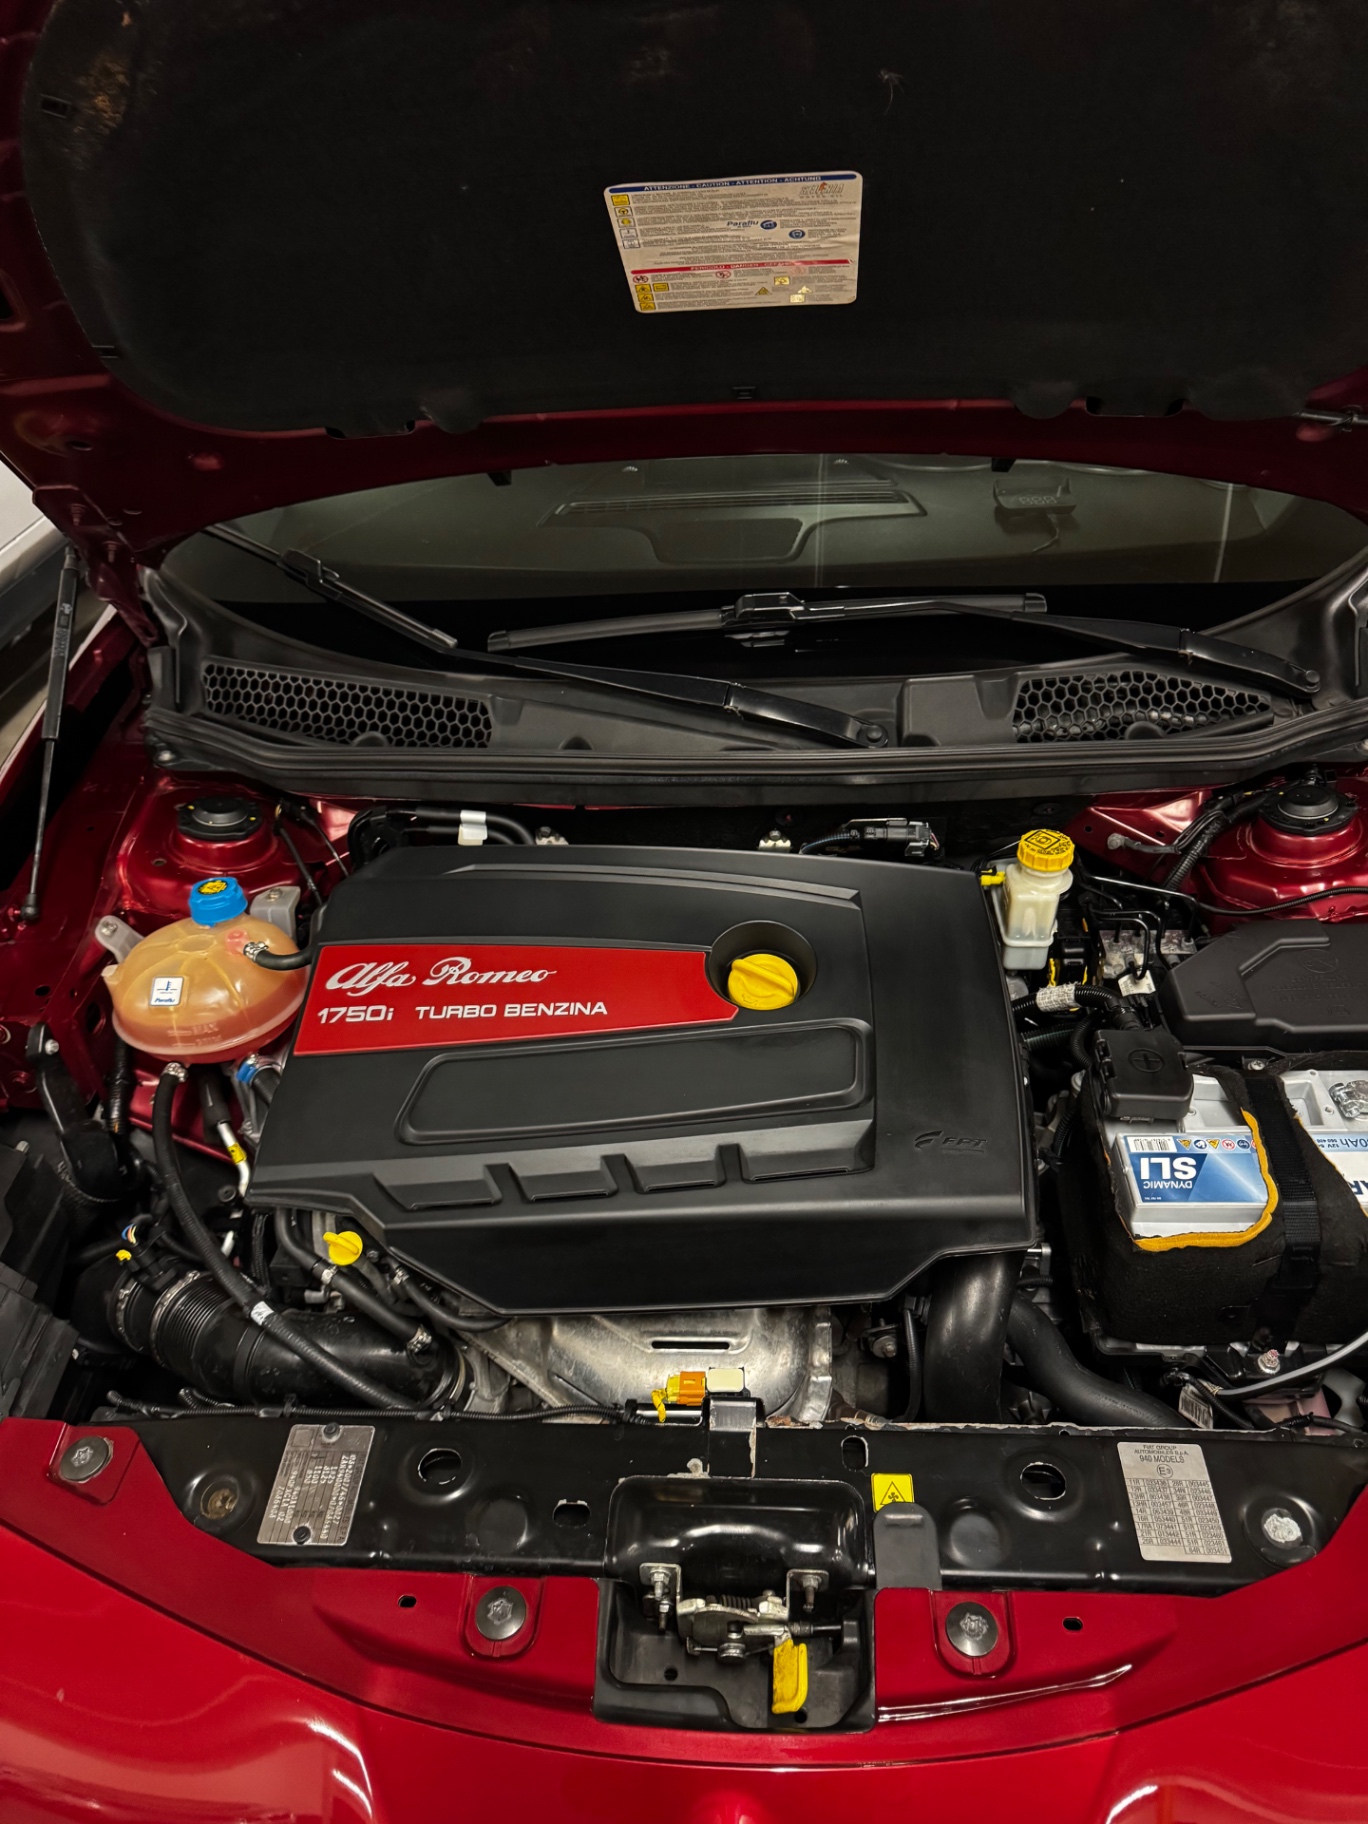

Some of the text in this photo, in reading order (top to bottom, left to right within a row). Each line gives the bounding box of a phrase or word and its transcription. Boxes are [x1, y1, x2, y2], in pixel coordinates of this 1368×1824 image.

[326, 956, 557, 996] Alfa Romeo
[317, 1002, 608, 1024] 1750i TURBO BENZINA
[1339, 1138, 1368, 1148] 0Ah
[1140, 1156, 1197, 1180] SLI
[1143, 1180, 1193, 1190] DYNAMIC
